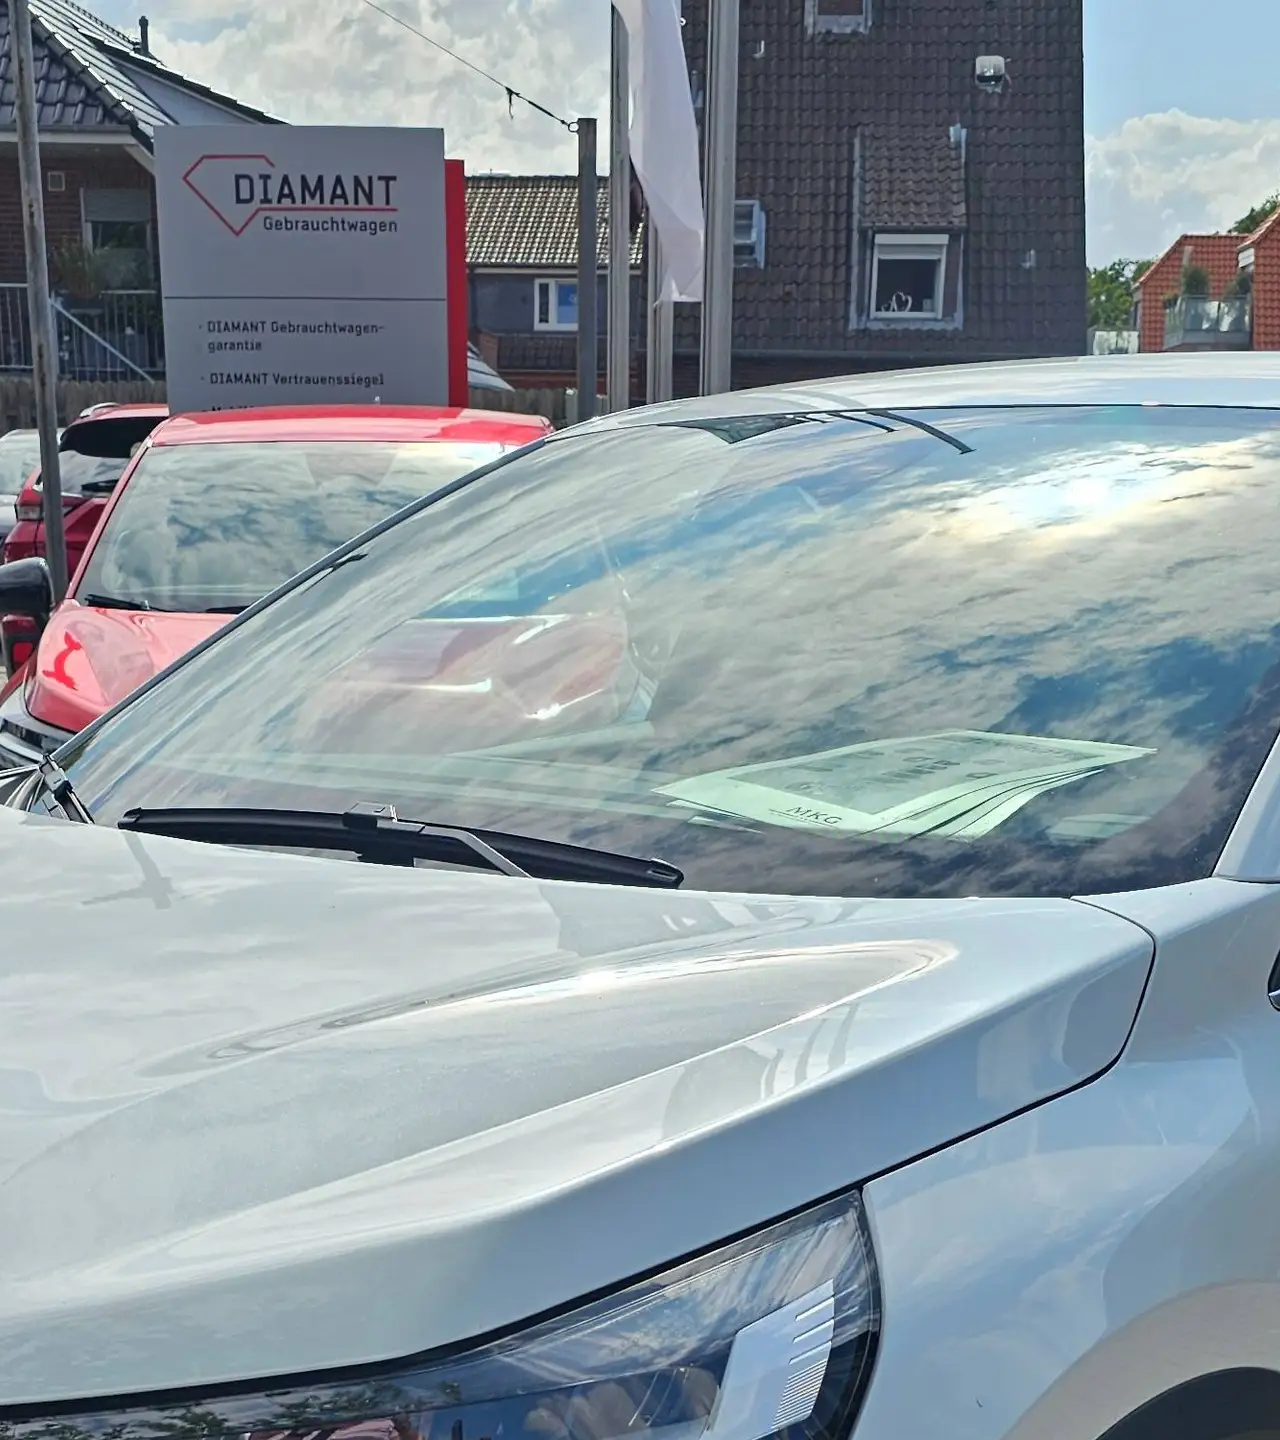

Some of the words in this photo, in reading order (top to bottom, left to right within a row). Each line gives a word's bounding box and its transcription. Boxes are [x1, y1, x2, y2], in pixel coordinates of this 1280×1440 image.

[234, 173, 398, 206] DIAMANT
[263, 216, 398, 236] Gebrauchtwagen
[207, 320, 267, 334] DIAMANT
[207, 339, 263, 354] garantie
[210, 372, 269, 386] DIAMANT
[272, 372, 385, 388] Vertrauenssiegel
